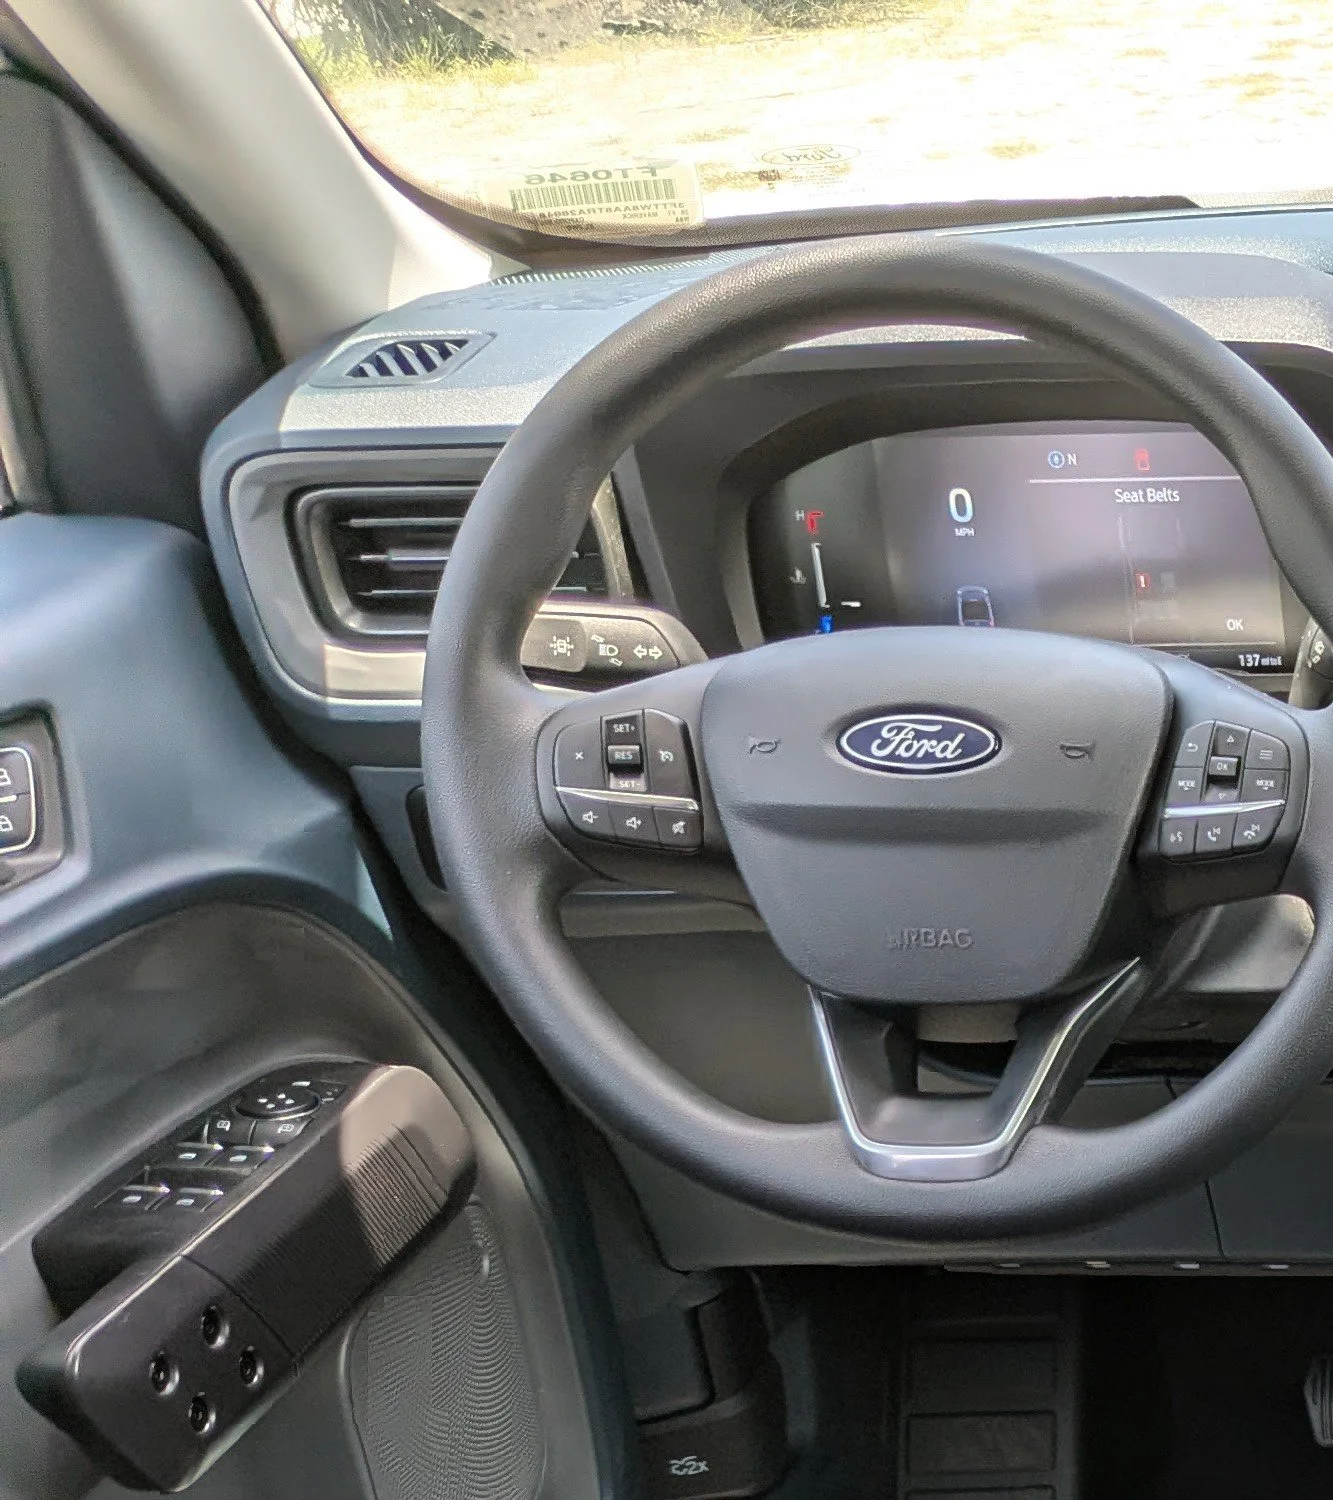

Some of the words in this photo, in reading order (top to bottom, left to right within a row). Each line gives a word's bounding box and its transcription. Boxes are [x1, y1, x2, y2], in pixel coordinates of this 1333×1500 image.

[1068, 454, 1077, 465] N
[1114, 489, 1144, 503] Seat
[1147, 488, 1180, 502] Belts
[949, 488, 974, 523] 0
[954, 528, 975, 537] MPH
[1227, 619, 1244, 631] OK
[1239, 654, 1260, 667] 137
[871, 722, 965, 760] Ford
[614, 751, 633, 760] RES
[1216, 763, 1229, 771] OK
[889, 927, 973, 948] AIRBAG
